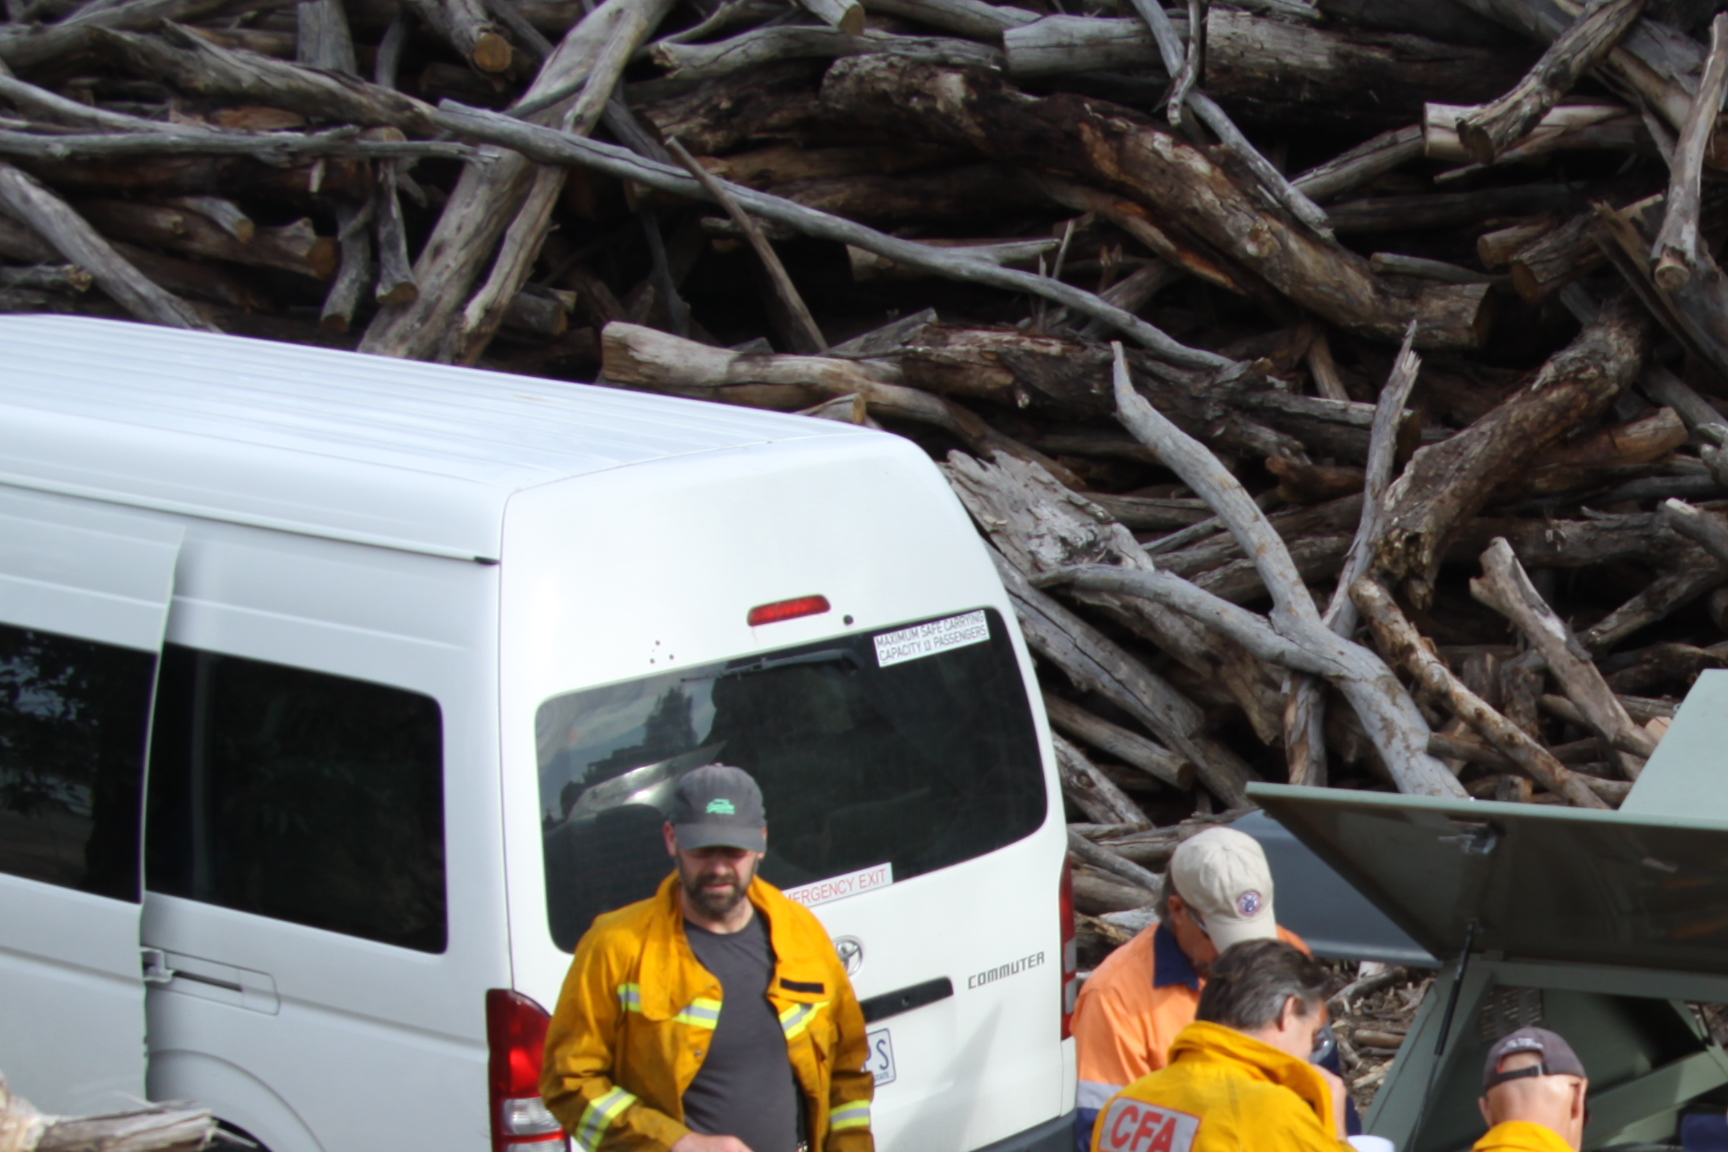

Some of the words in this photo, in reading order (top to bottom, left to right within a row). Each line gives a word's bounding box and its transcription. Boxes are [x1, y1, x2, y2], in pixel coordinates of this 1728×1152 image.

[876, 627, 919, 646] MAXIMUM
[920, 621, 942, 637] SAFE
[943, 610, 984, 631] CARRYING
[880, 642, 921, 661] CAPACITY
[933, 625, 987, 648] PASSENGERS
[787, 876, 856, 904] ERGENCY
[858, 868, 887, 889] EXIT
[967, 951, 1045, 990] COMMUTER
